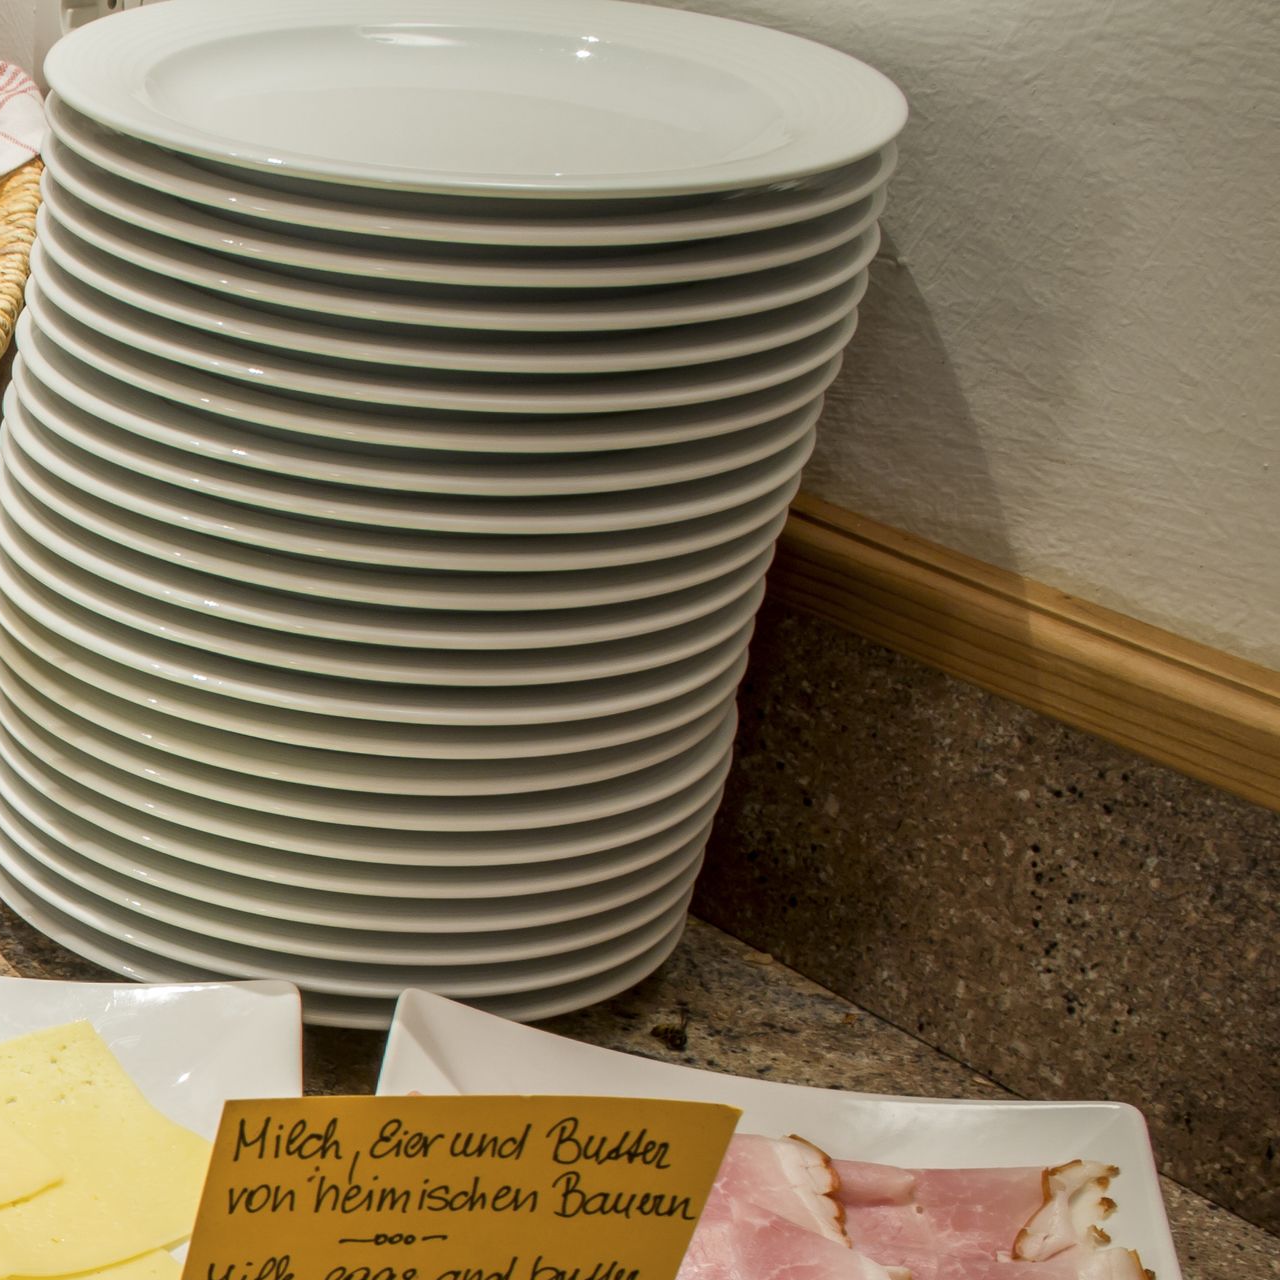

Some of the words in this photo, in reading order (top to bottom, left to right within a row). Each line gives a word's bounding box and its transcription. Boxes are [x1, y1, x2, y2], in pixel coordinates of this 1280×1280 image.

[232, 1115, 361, 1186] Milch,
[368, 1117, 446, 1160] Eier
[448, 1122, 533, 1161] und
[545, 1116, 672, 1170] Butter
[227, 1183, 296, 1215] von
[551, 1170, 697, 1221] Bauern
